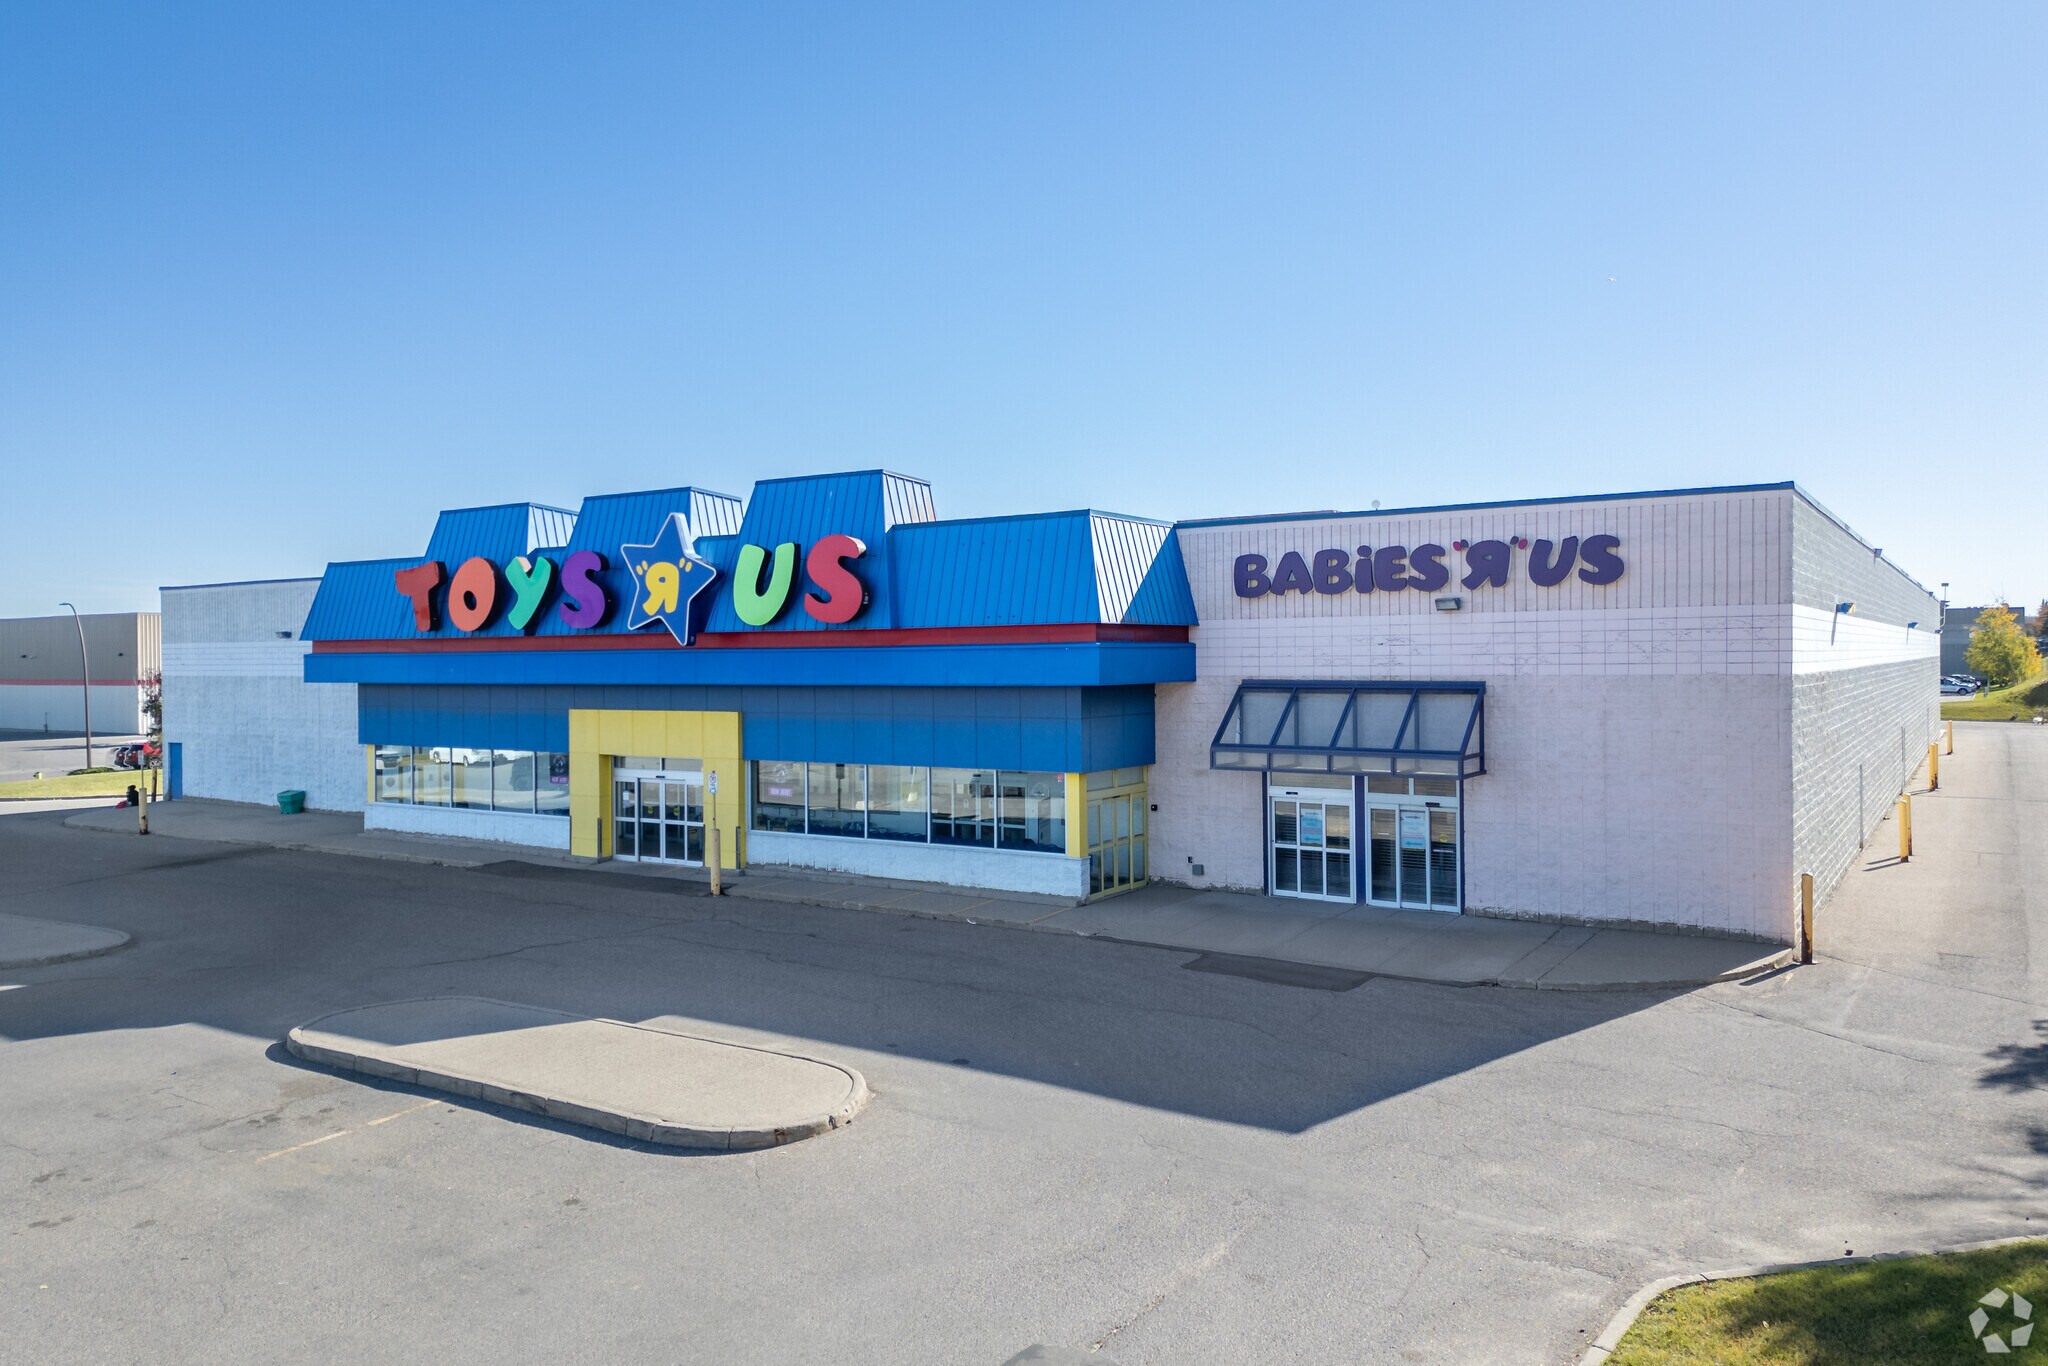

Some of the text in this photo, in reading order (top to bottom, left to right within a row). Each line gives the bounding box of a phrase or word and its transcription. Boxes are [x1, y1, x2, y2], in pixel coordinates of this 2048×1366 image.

[395, 550, 607, 632] TOYS
[733, 534, 867, 626] US
[1528, 534, 1625, 587] US
